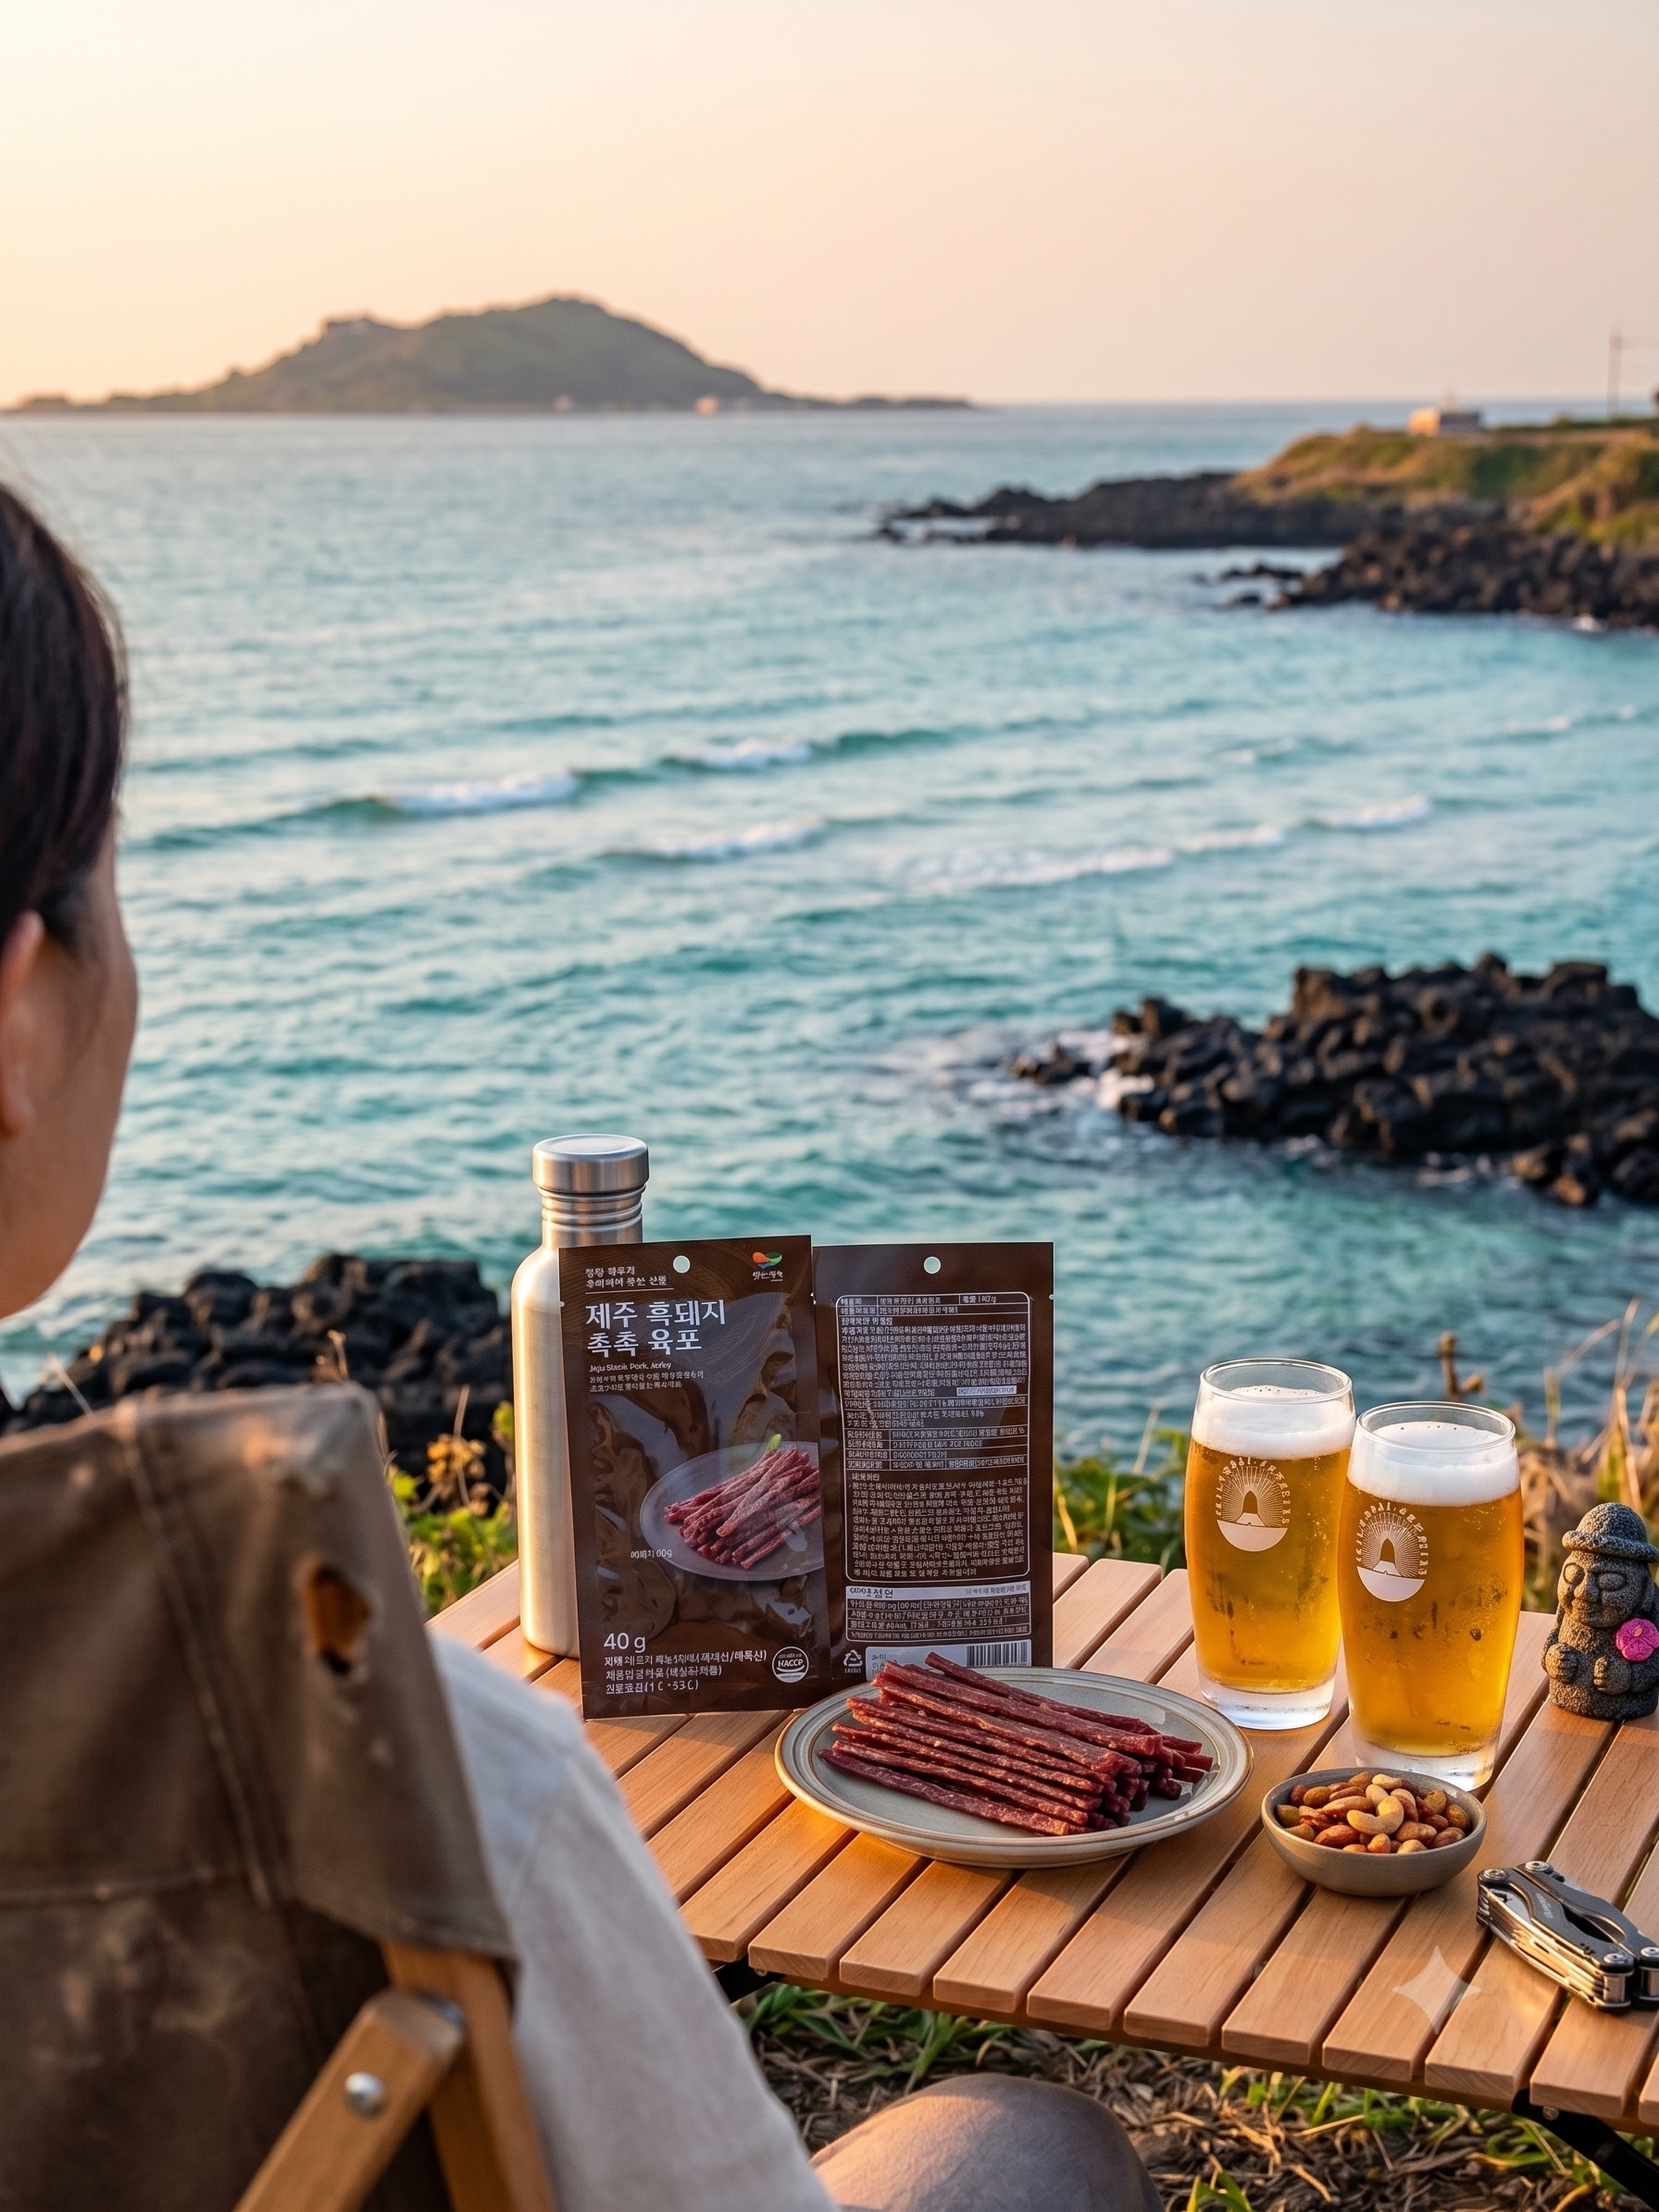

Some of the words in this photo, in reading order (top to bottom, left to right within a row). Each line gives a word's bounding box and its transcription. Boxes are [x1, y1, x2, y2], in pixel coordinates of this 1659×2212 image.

[585, 1301, 638, 1329] 제주
[646, 1299, 726, 1326] 흑돼지
[587, 1331, 639, 1358] 촉촉
[647, 1328, 702, 1355] 육포
[604, 1632, 630, 1650] 40
[633, 1636, 646, 1654] g
[778, 1659, 804, 1667] HACCP
